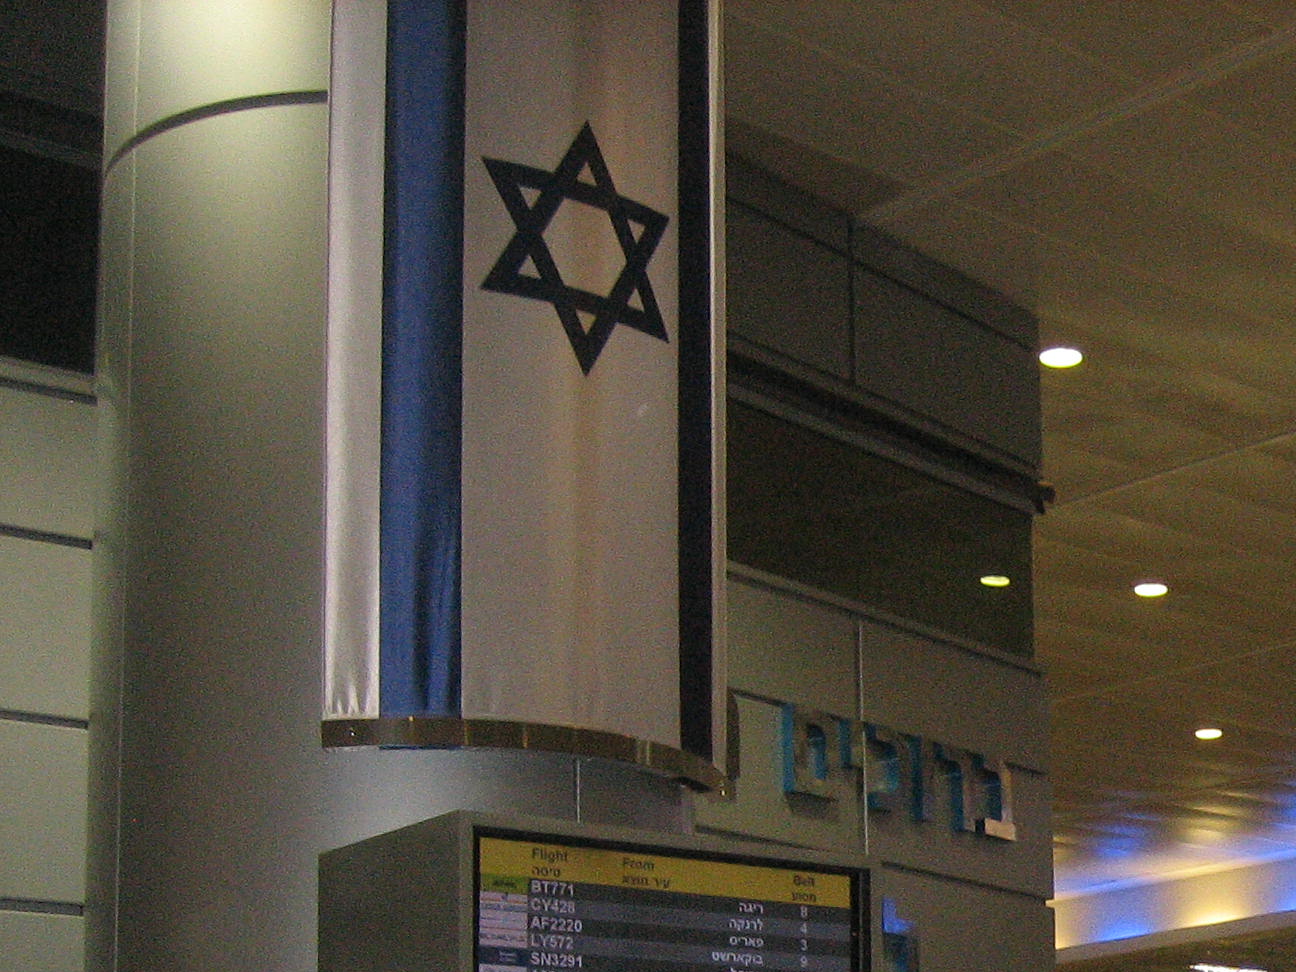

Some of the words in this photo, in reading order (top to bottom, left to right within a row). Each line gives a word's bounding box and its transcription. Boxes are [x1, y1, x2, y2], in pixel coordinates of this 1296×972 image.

[531, 848, 568, 862] Flight
[622, 857, 655, 871] From
[531, 879, 575, 897] BT771
[531, 897, 576, 913] CY428
[738, 901, 764, 915] ריגה
[530, 915, 583, 932] AF2220
[729, 918, 763, 932] לרנקה
[530, 933, 575, 950] LY572
[729, 936, 764, 948] פאריס
[799, 940, 808, 952] 3
[530, 952, 583, 968] SN3291
[712, 951, 764, 968] בוקארשט
